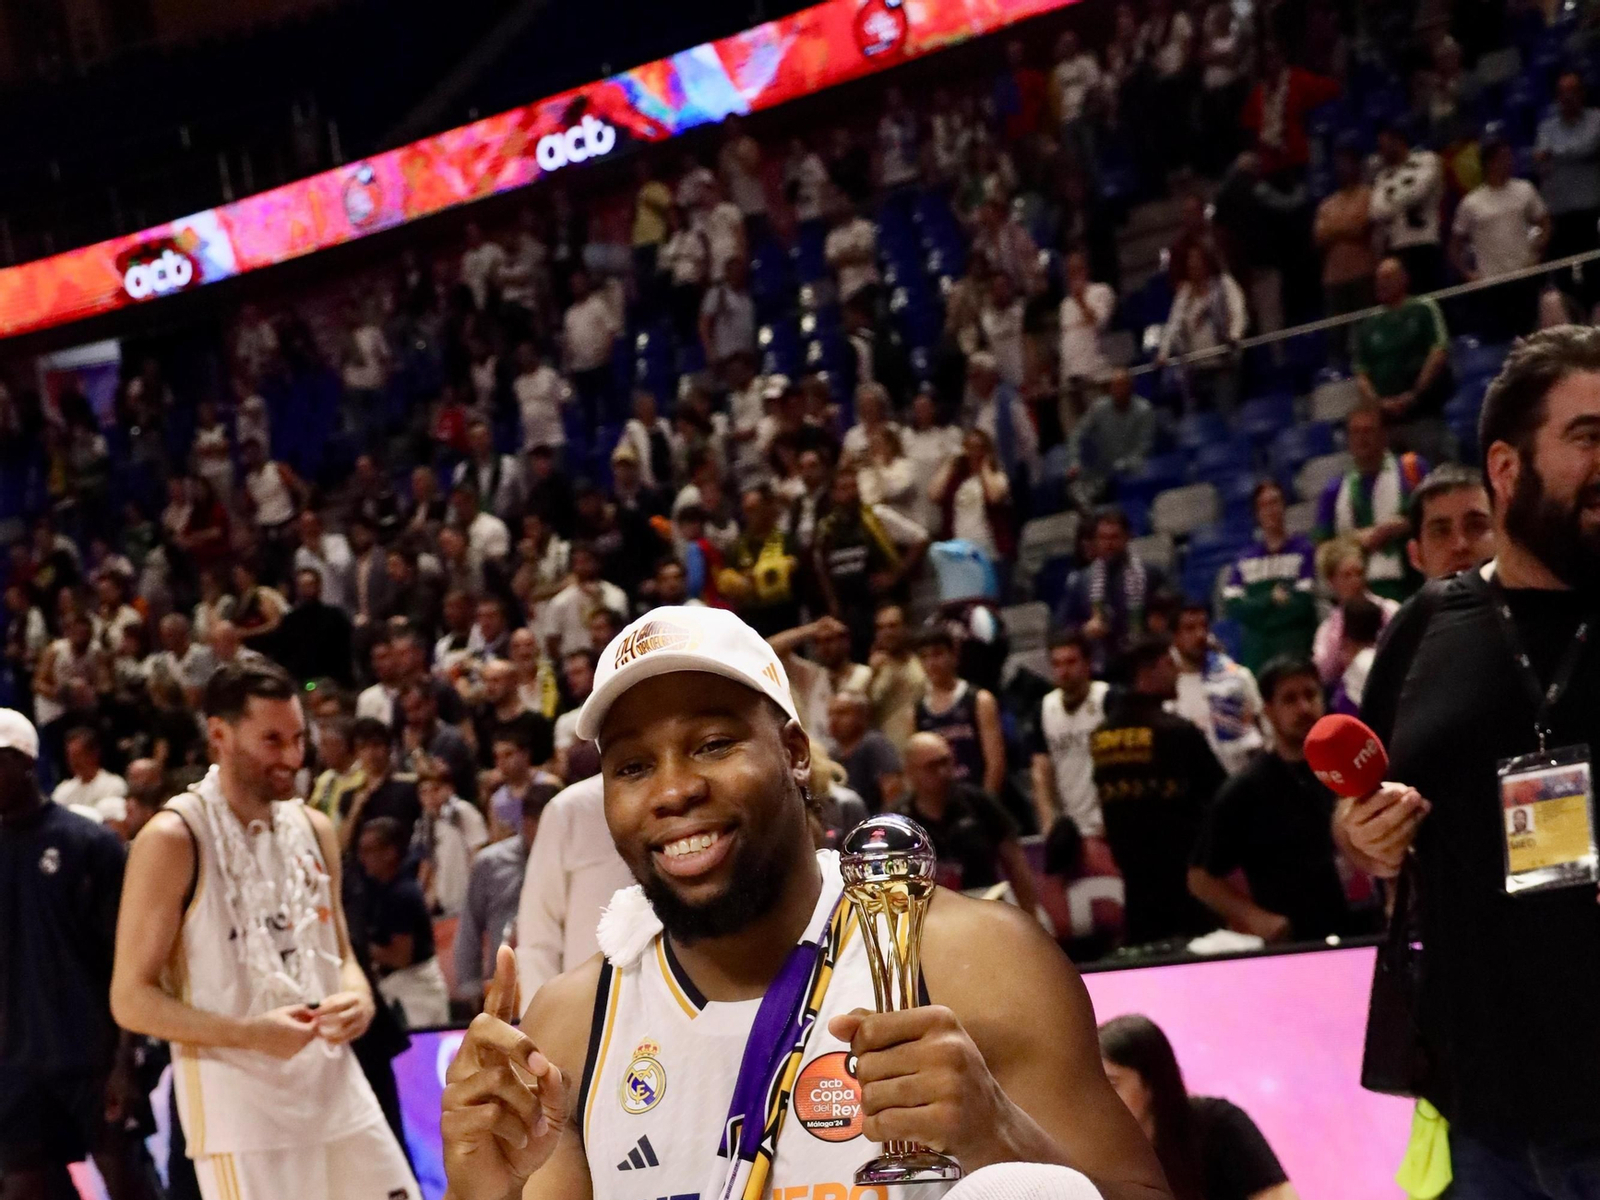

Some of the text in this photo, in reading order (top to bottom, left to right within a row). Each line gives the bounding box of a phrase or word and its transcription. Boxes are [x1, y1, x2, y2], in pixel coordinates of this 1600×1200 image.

[534, 112, 617, 172] acb
[123, 248, 193, 300] acb
[819, 1078, 844, 1089] acb
[810, 1088, 855, 1104] Copa
[813, 1103, 861, 1118] del Rey
